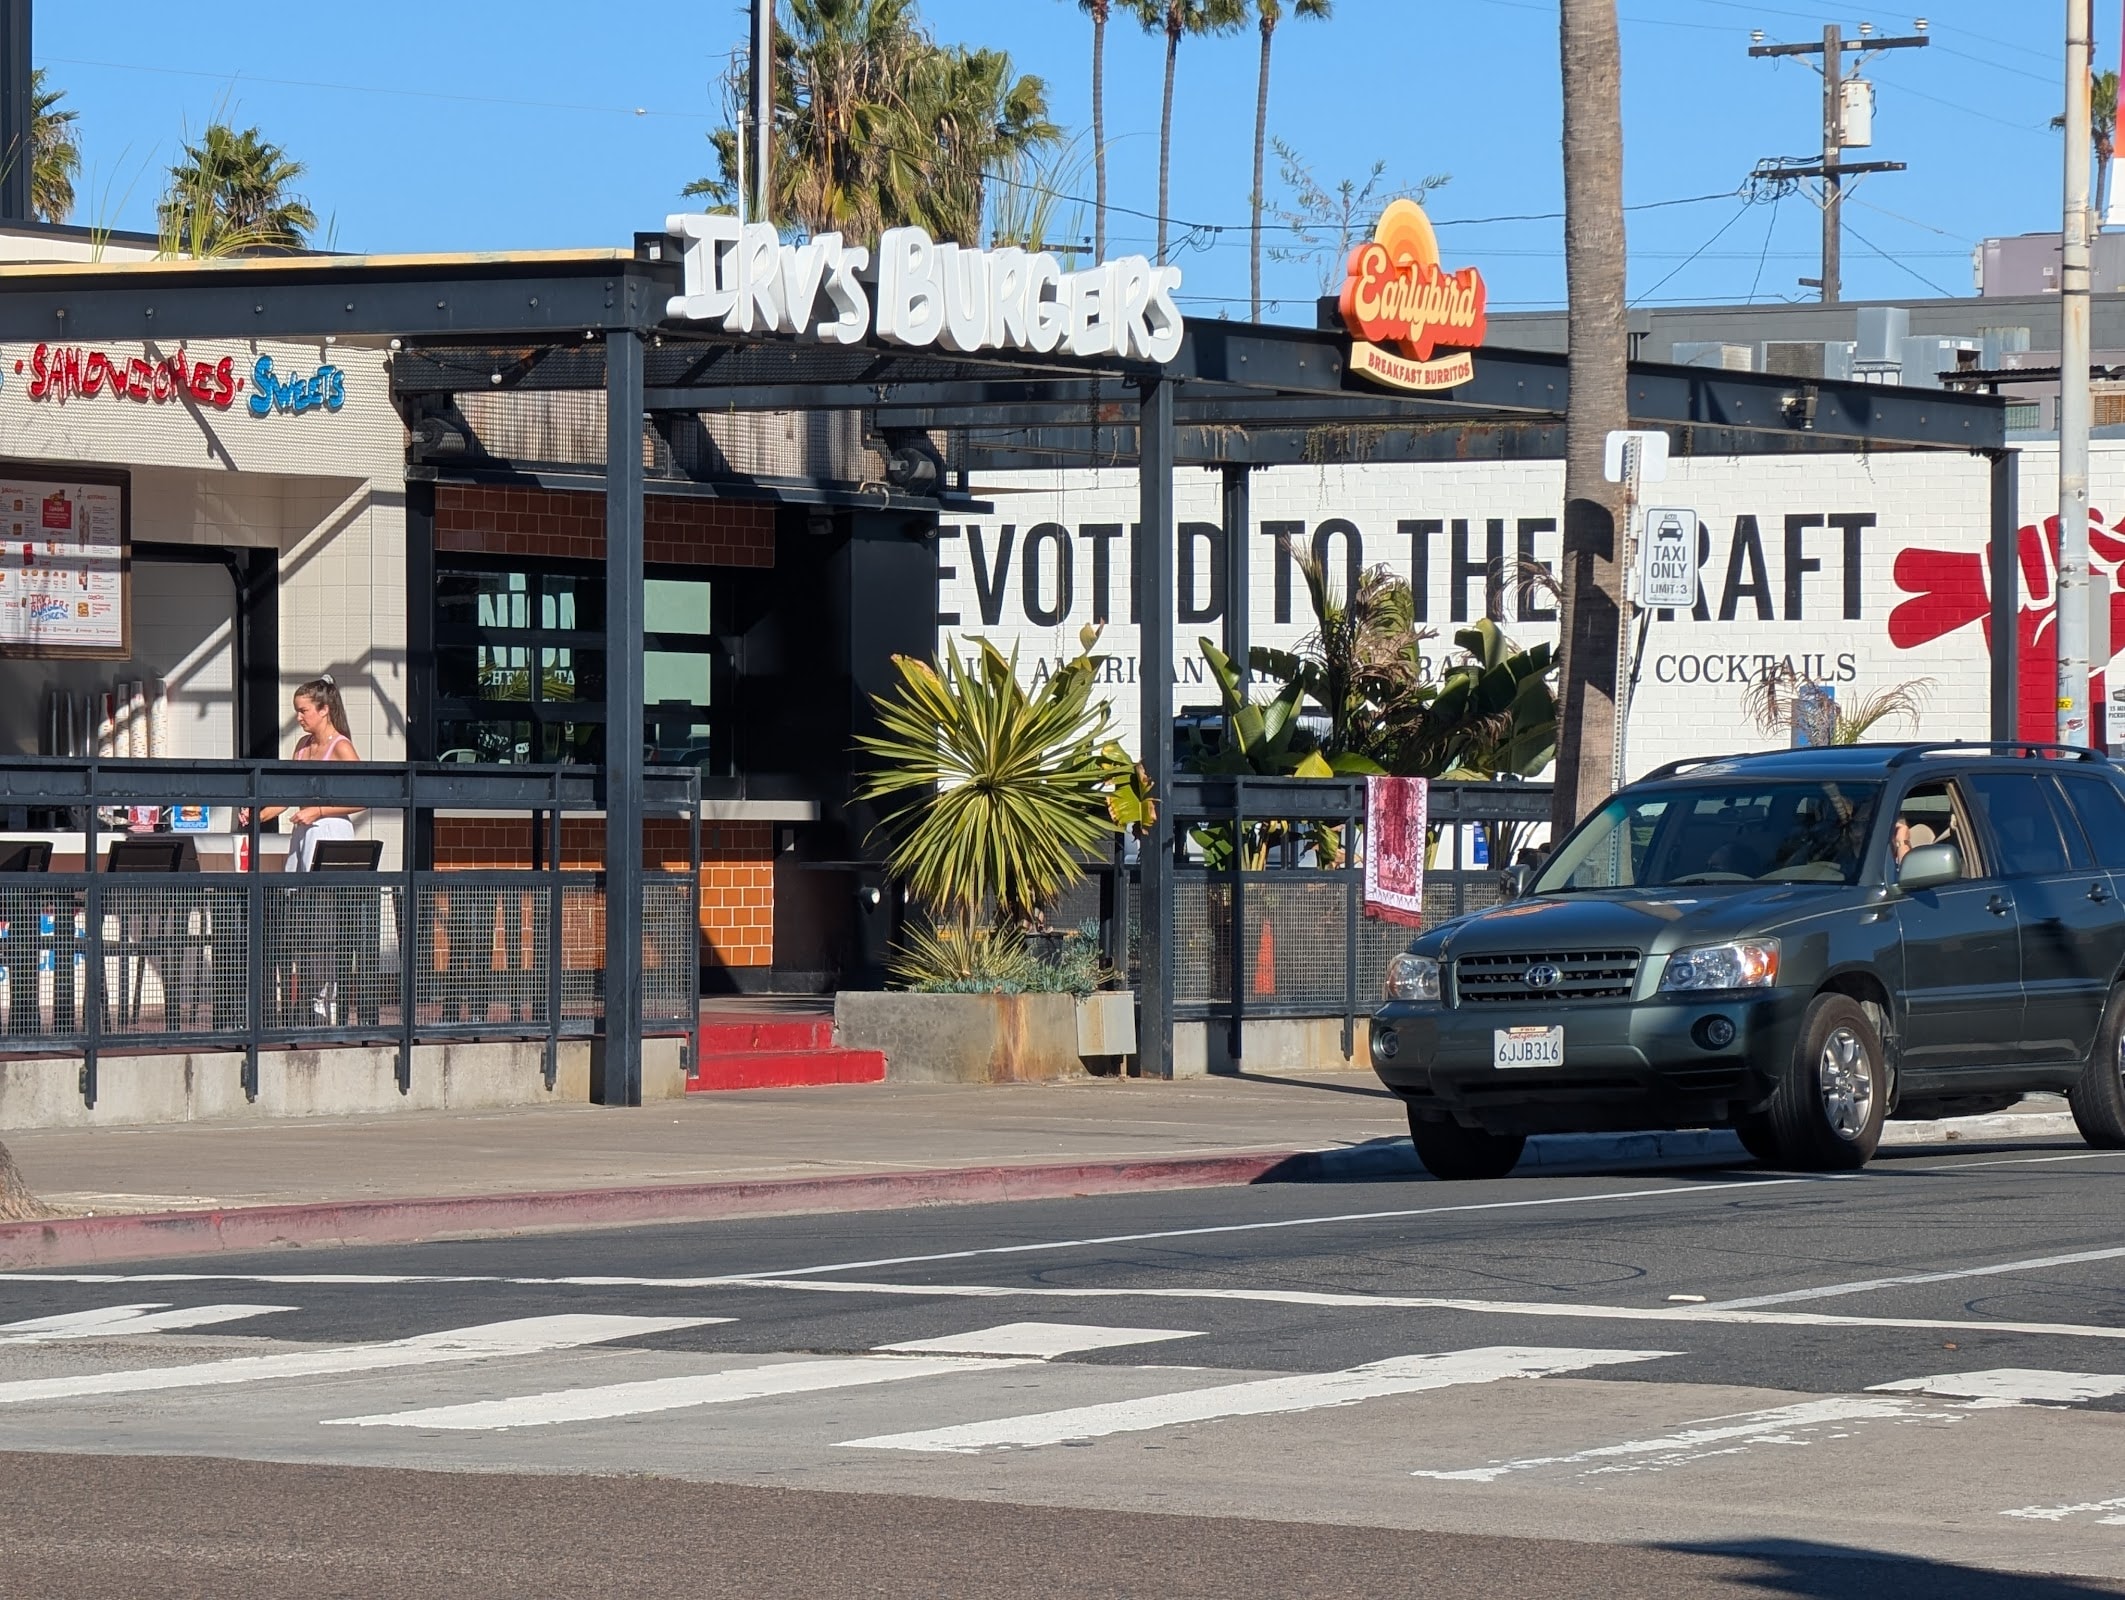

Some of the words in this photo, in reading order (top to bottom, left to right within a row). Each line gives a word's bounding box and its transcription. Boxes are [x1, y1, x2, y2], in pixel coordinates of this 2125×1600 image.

[665, 213, 870, 343] IRV'S
[876, 225, 1184, 363] BURGERS
[1355, 244, 1476, 342] Earlybird
[29, 343, 236, 407] SANDWICHES
[1368, 351, 1423, 385] BREAKFAST
[1424, 362, 1470, 385] BURRITOS
[1651, 562, 1688, 579] ONLY
[1653, 546, 1686, 561] TAXI
[937, 522, 1224, 627] EVOTD
[1260, 517, 1363, 624] TO
[1397, 517, 1558, 623] THE
[1655, 652, 1857, 684] COCKTAILS
[1498, 1041, 1559, 1062] 6JJB316
